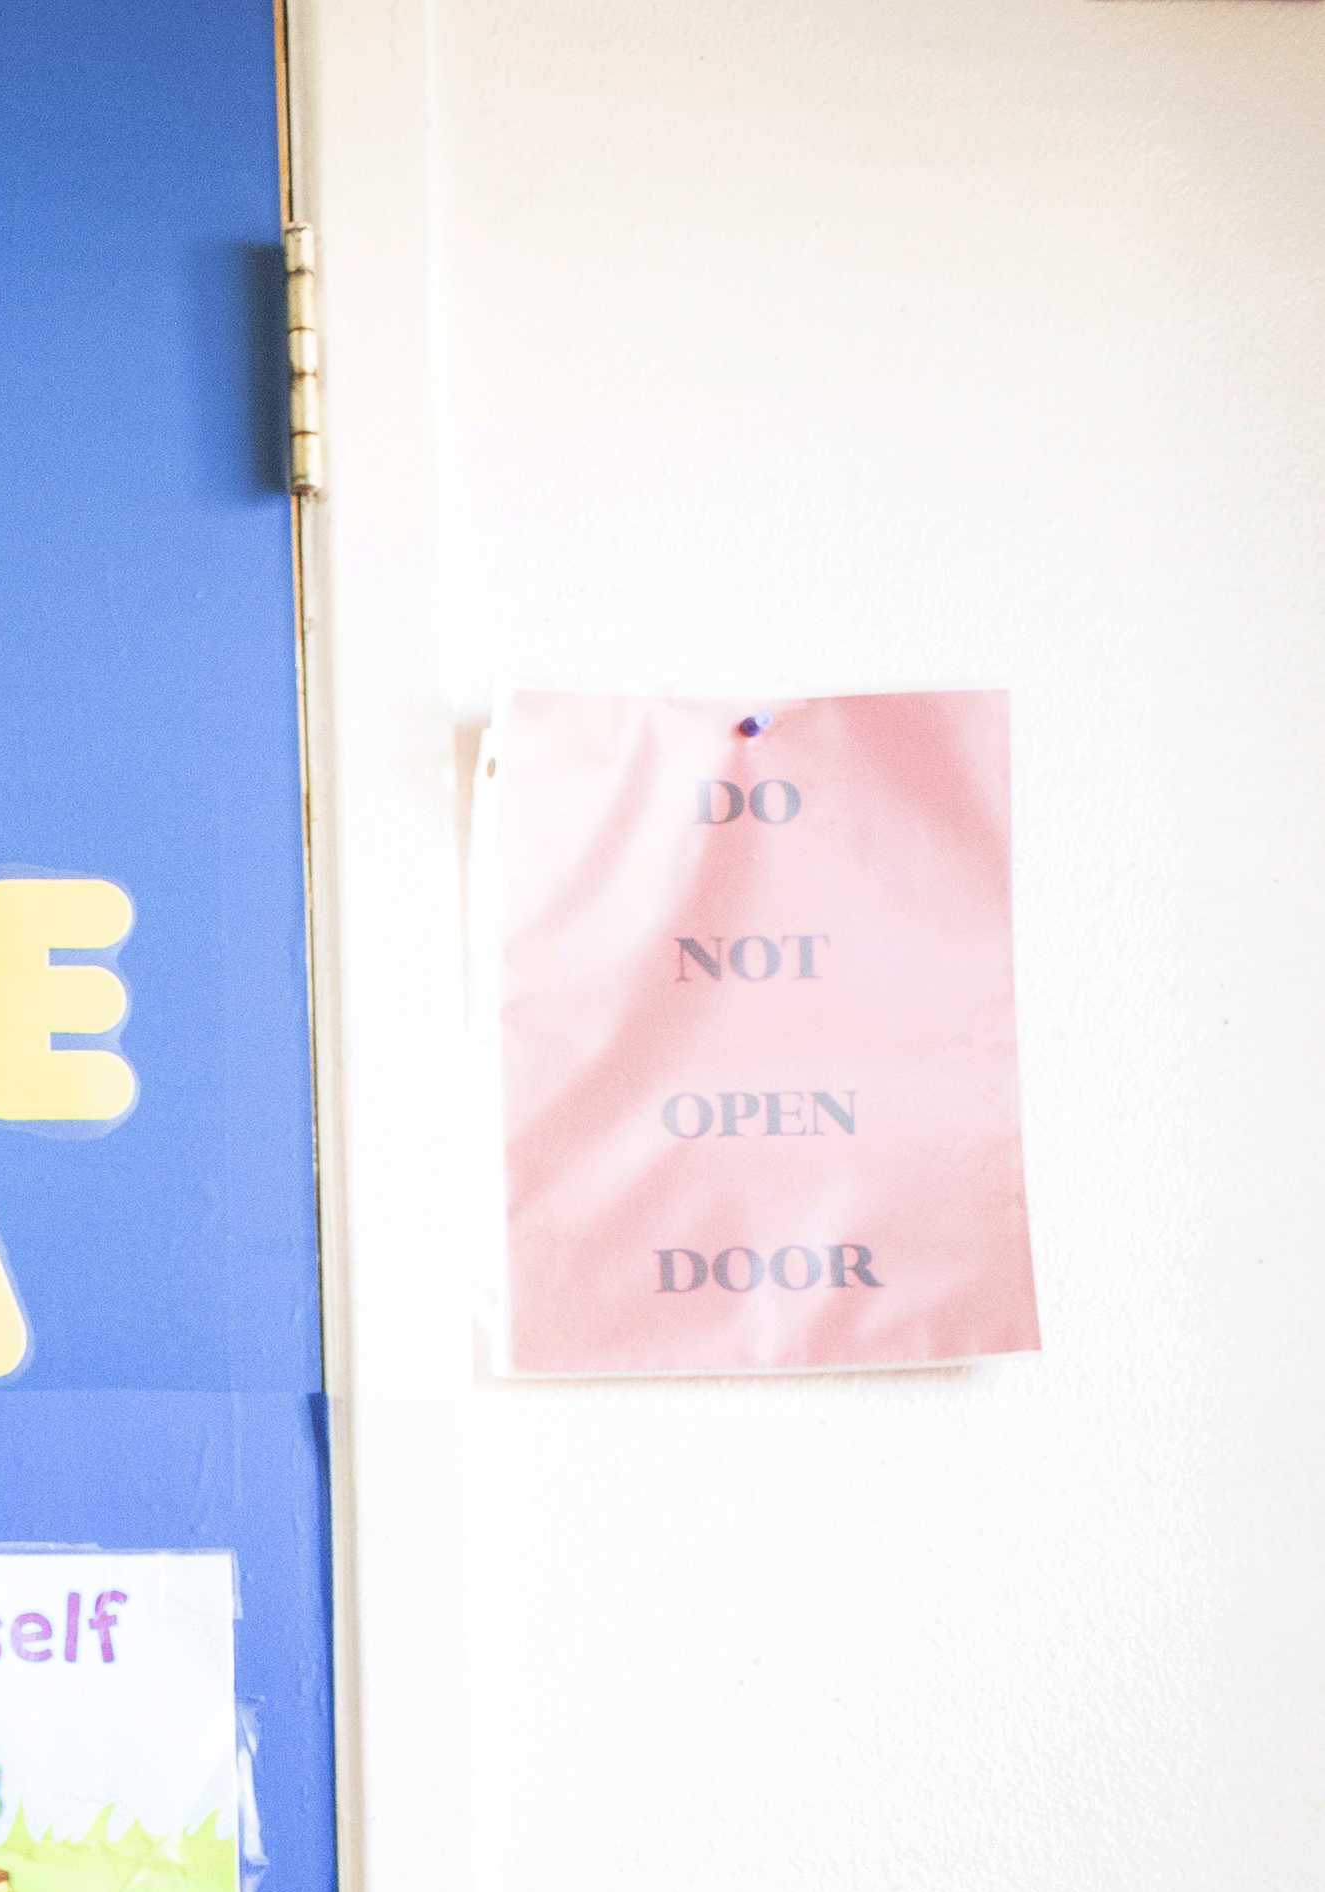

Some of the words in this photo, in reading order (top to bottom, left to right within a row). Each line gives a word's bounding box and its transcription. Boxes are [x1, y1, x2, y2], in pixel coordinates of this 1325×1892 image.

[694, 778, 802, 824] DO
[674, 933, 830, 983] NOT
[662, 1090, 859, 1139] OPEN
[653, 1243, 884, 1293] DOOR
